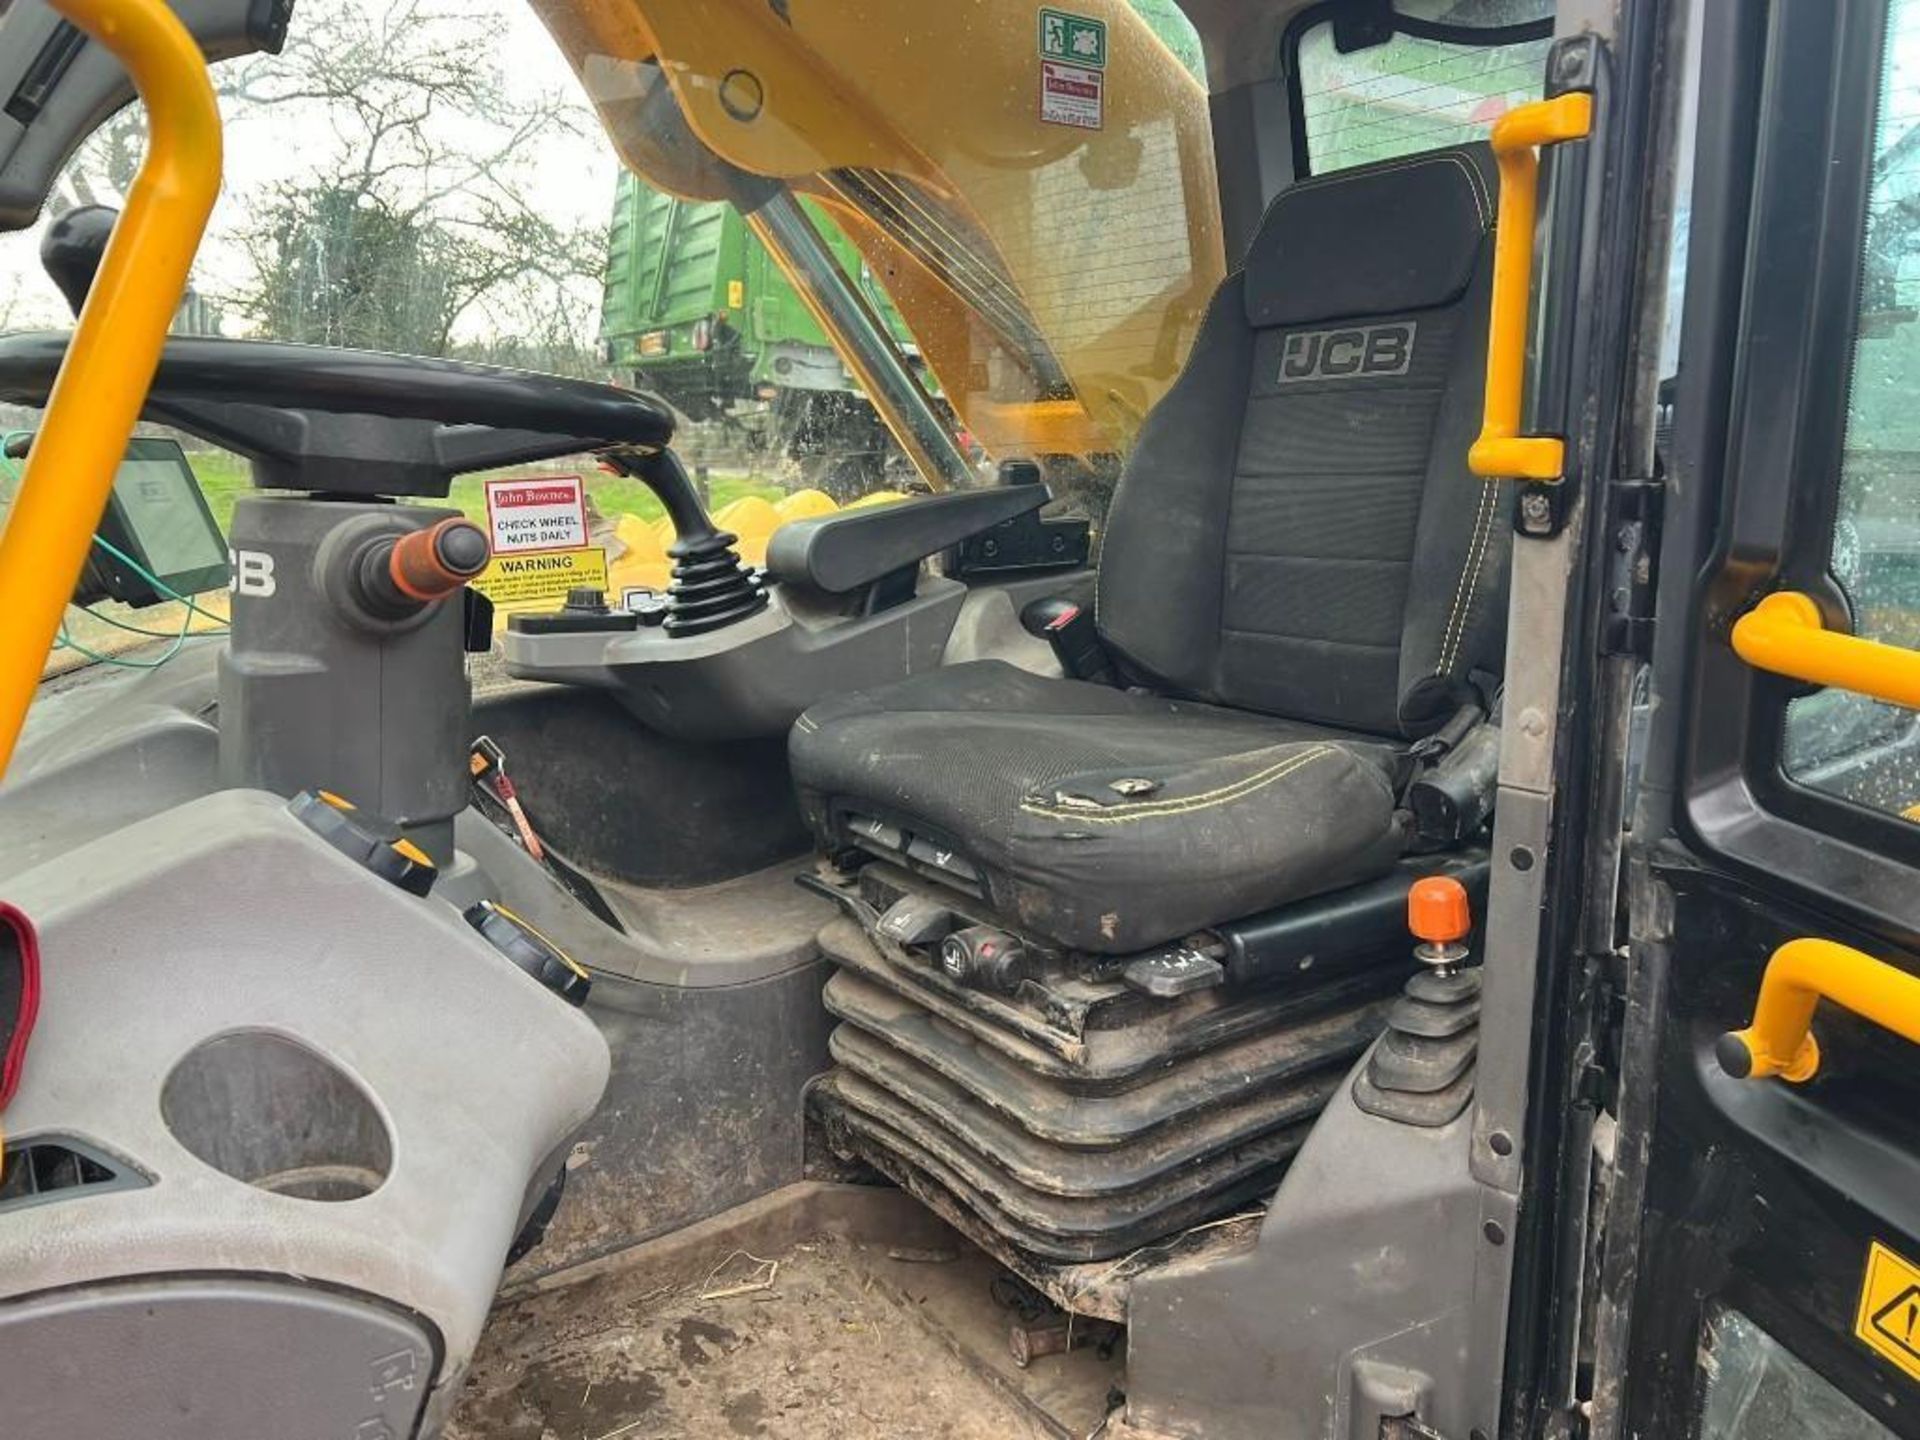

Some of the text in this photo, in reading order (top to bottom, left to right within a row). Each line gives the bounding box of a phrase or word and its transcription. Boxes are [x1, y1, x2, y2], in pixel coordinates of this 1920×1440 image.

[1279, 325, 1413, 380] JCB
[497, 491, 523, 505] John
[498, 516, 579, 531] CHECK WHEEL
[507, 529, 571, 544] NUTS DAILY
[500, 556, 573, 573] WARNING
